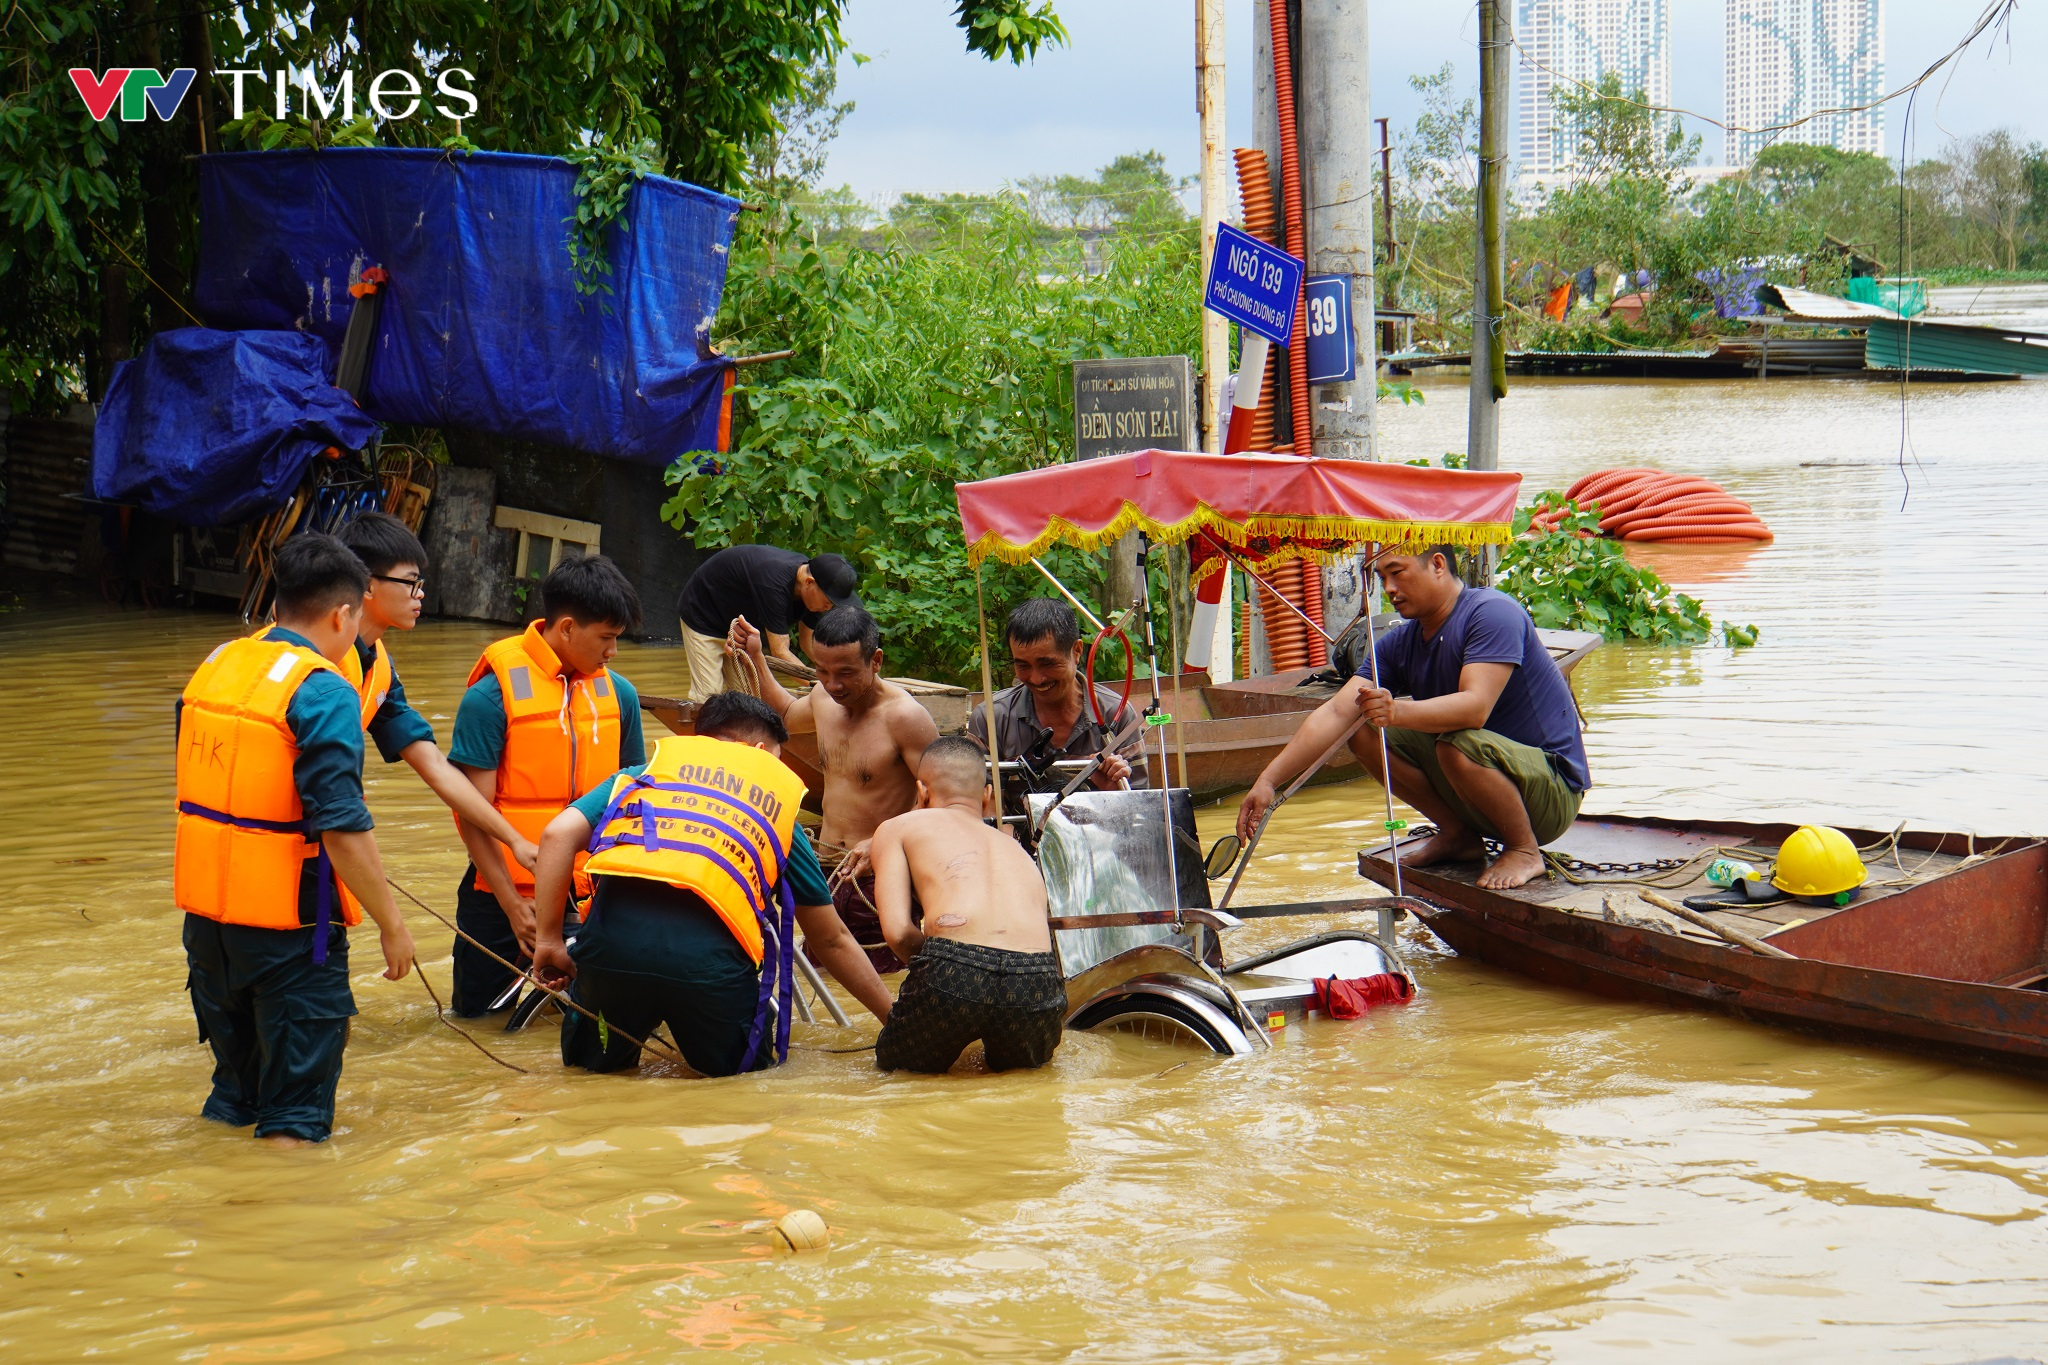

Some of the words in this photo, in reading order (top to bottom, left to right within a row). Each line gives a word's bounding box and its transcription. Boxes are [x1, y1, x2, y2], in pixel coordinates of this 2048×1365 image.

[1228, 244, 1259, 282] NGÕ
[1261, 261, 1283, 294] 139
[1214, 279, 1230, 299] PHỐ
[1275, 310, 1286, 332] ĐỘ
[1091, 376, 1108, 391] TÍCH
[1127, 372, 1139, 391] SỬ
[1140, 374, 1157, 390] VĂN
[1081, 397, 1112, 439] ĐỀN
[1115, 407, 1146, 438] SƠN
[1150, 397, 1178, 438] HẢI
[678, 764, 745, 797] QUÂN
[631, 818, 676, 830] TỦ
[684, 823, 716, 839] ĐÔ
[671, 795, 698, 807] BỘ
[705, 801, 731, 815] TƯ
[732, 812, 766, 851] LỆNH
